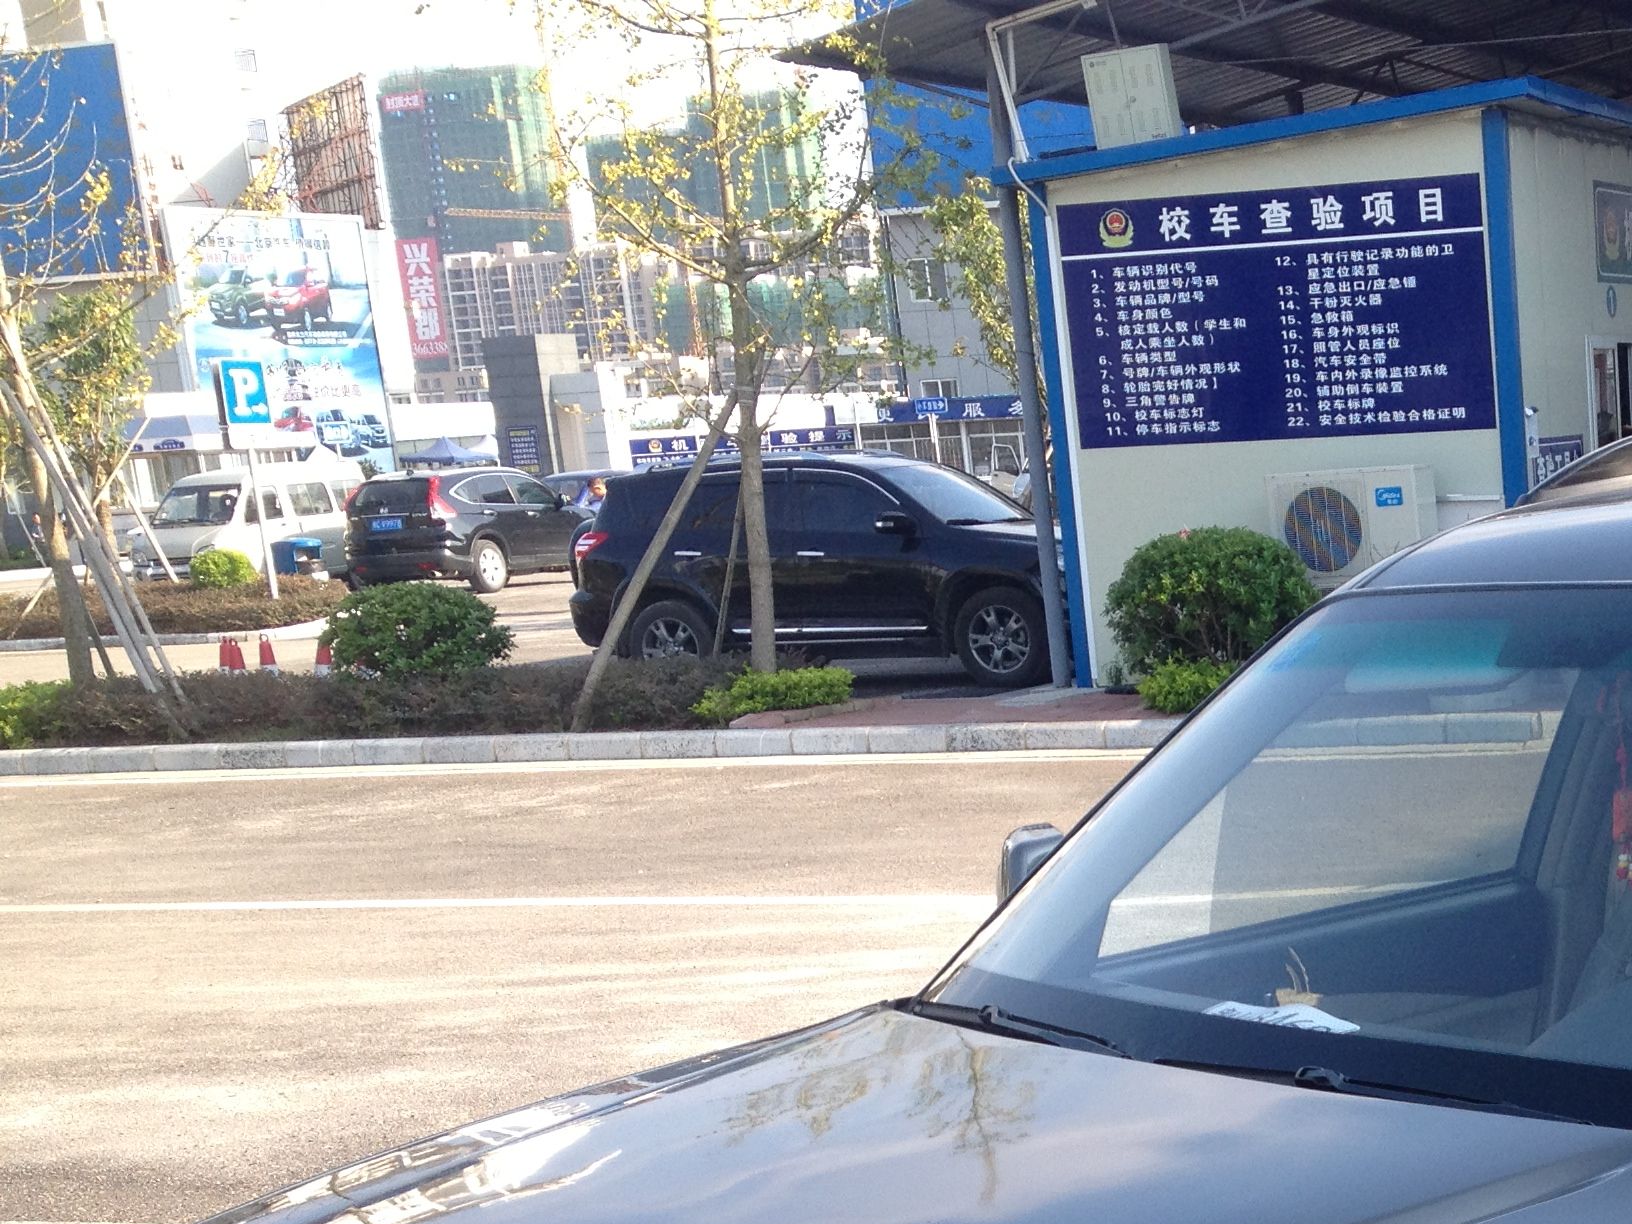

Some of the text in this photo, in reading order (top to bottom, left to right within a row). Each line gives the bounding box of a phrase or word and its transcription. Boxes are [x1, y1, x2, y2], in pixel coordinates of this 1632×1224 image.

[1158, 188, 1444, 242] 校车查验项目
[229, 368, 260, 416] P
